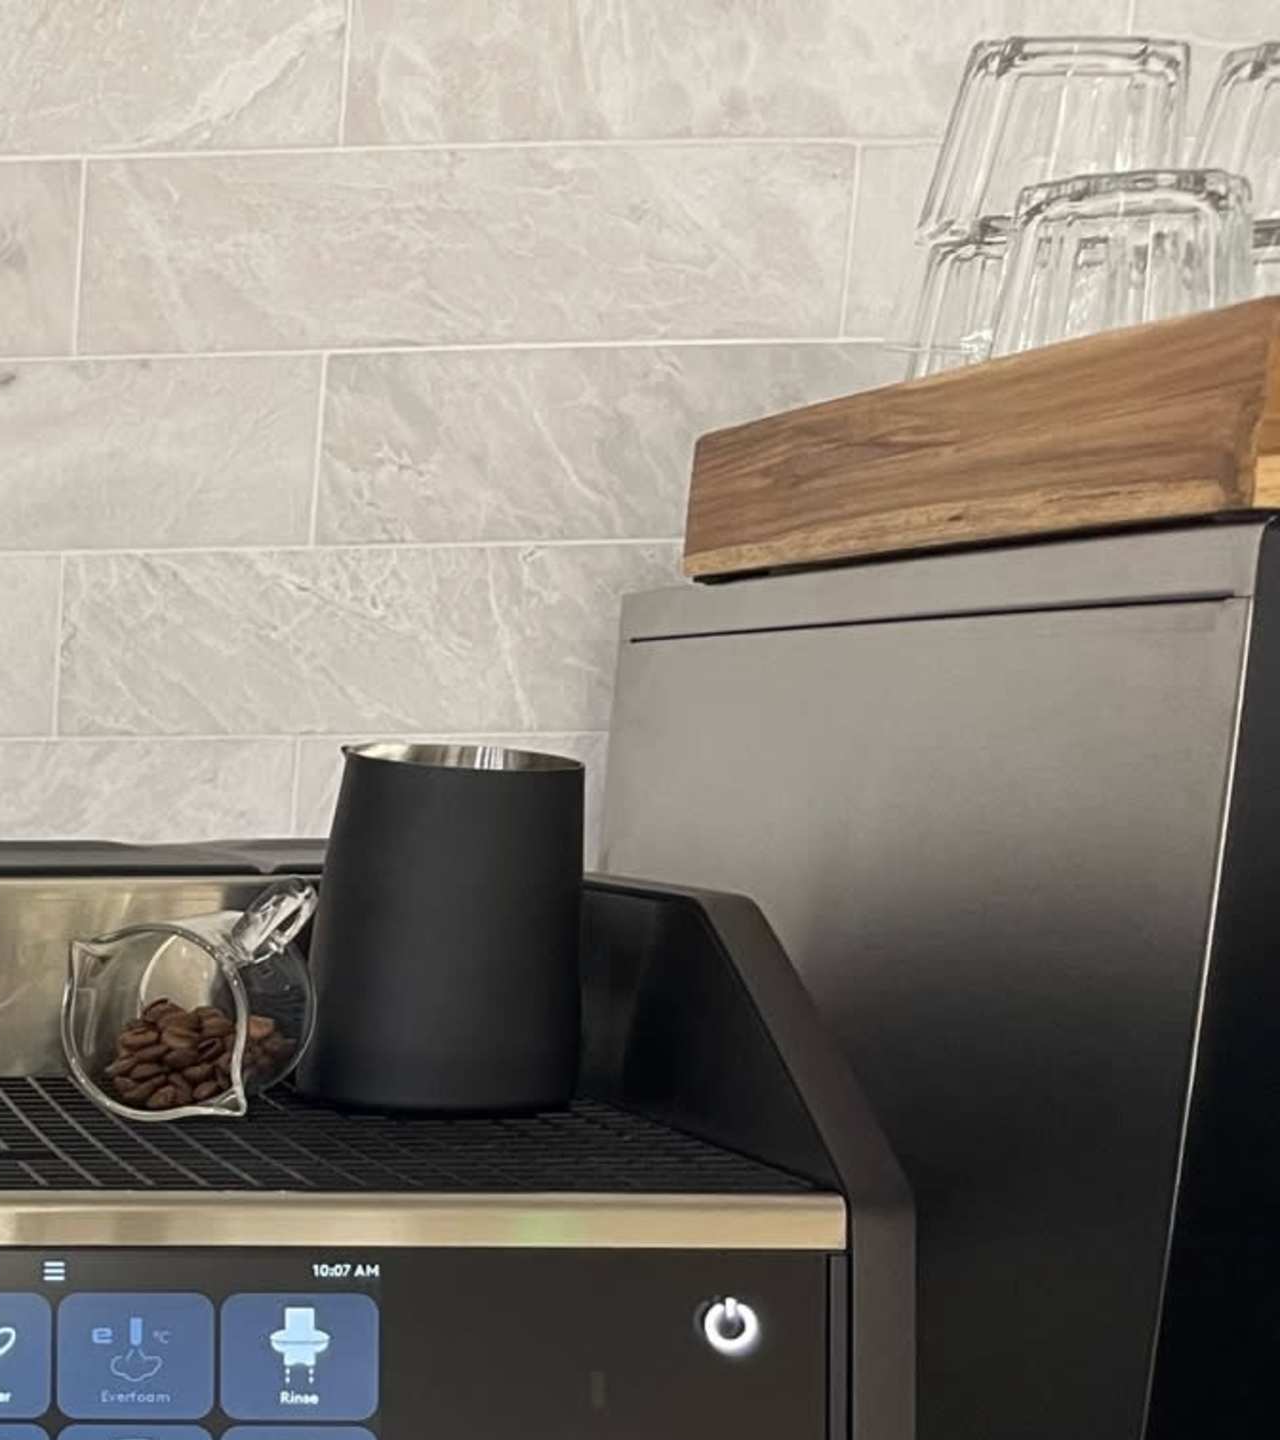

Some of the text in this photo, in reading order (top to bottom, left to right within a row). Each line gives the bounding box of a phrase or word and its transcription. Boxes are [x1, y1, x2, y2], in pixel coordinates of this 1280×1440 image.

[312, 1264, 380, 1278] 10:07 AM
[100, 1389, 171, 1403] Everfoam
[279, 1391, 319, 1405] Rinse
